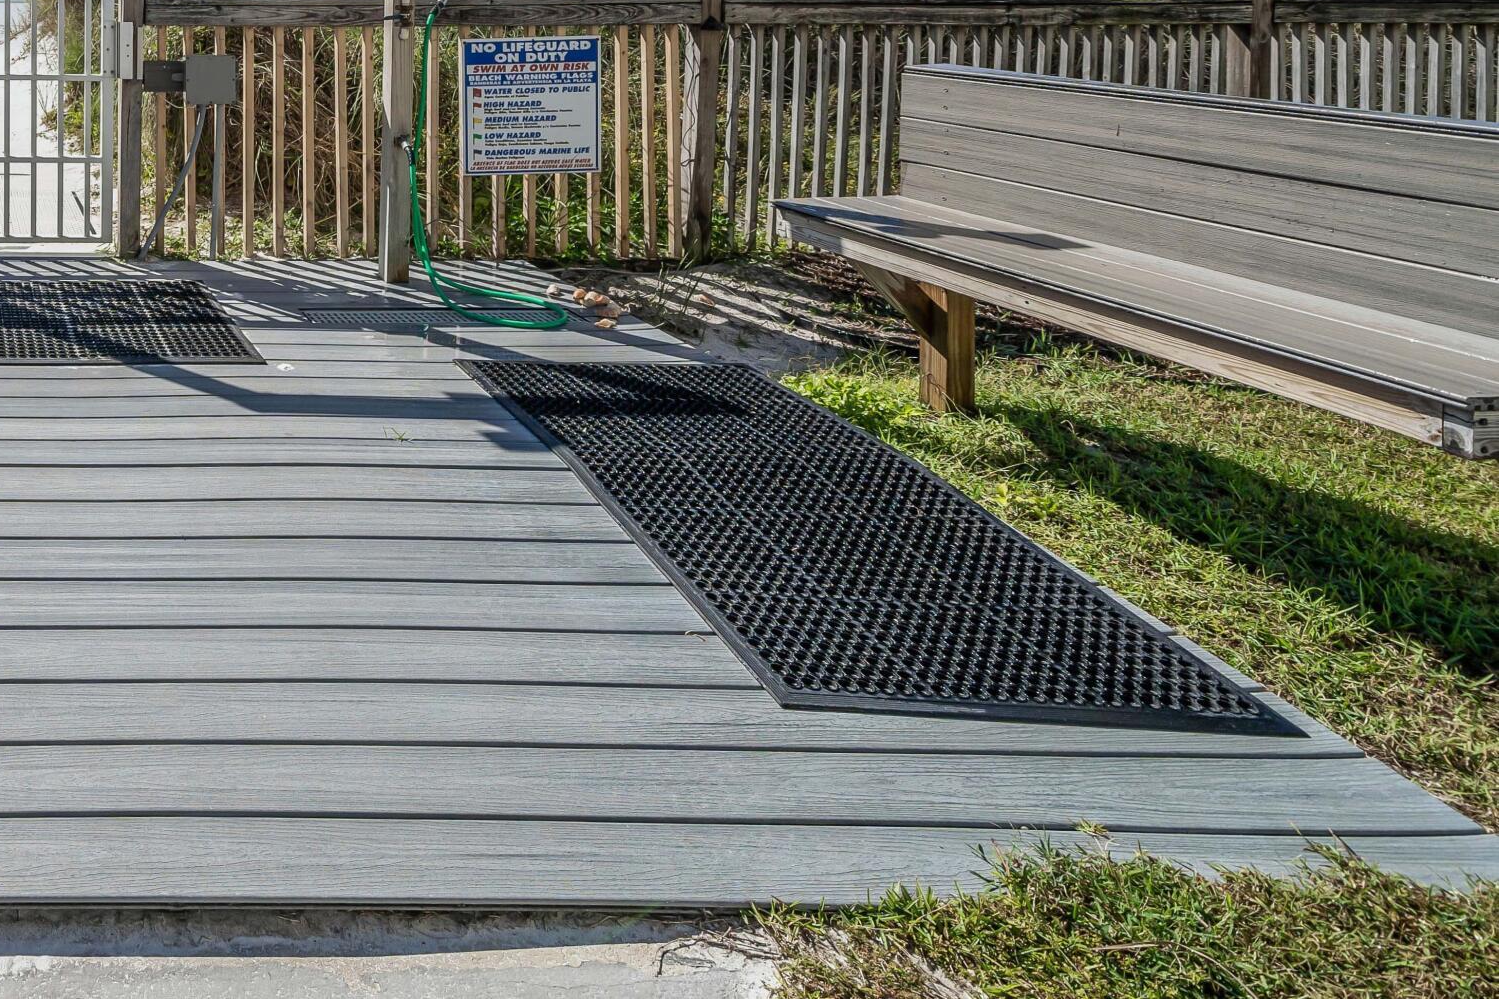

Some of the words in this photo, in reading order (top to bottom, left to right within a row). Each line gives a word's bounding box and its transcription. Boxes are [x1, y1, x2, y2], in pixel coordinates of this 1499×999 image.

[471, 43, 496, 53] NO
[502, 40, 592, 53] LIFEGUARD
[494, 53, 520, 63] ON
[525, 51, 568, 62] DUTY
[473, 64, 507, 73] SWIM
[511, 64, 525, 72] AT
[529, 63, 559, 72] OWN
[563, 62, 590, 71] RISK
[468, 74, 502, 82] BEACH
[505, 73, 558, 81] WARNING
[484, 148, 536, 156] DANGEROUS
[539, 147, 572, 155] MARINE
